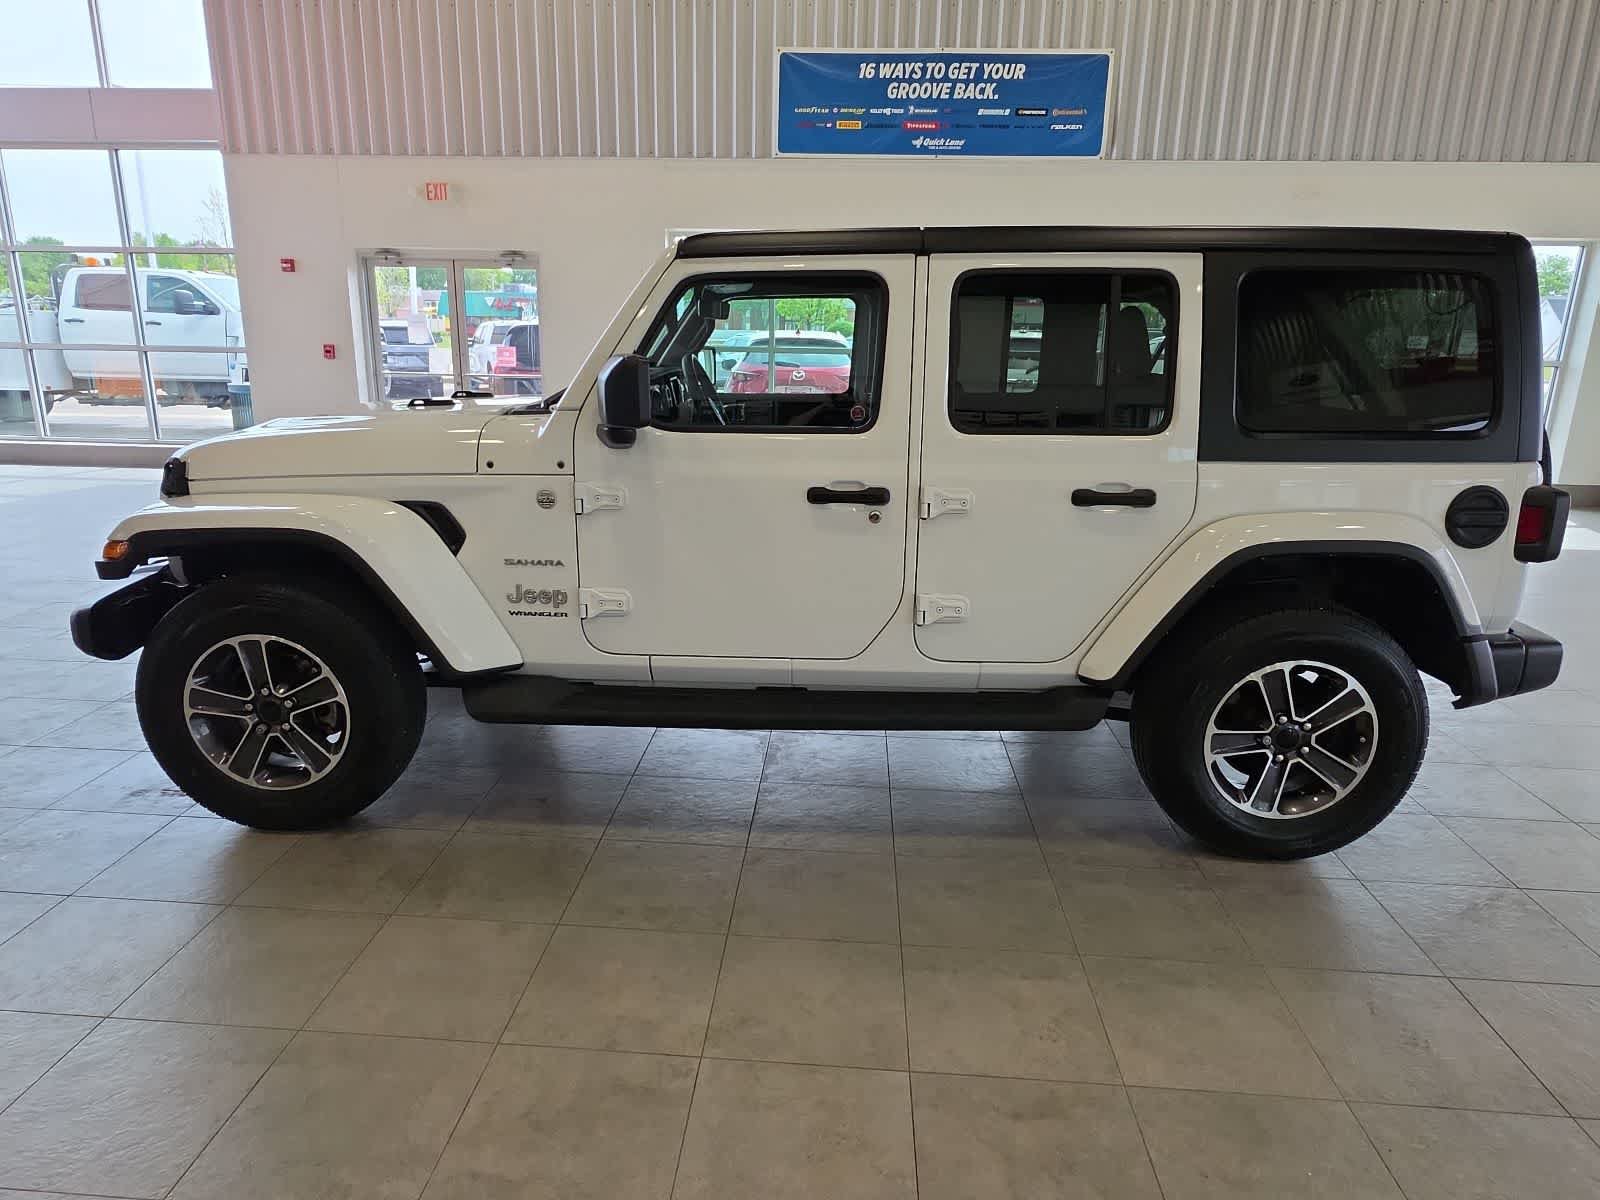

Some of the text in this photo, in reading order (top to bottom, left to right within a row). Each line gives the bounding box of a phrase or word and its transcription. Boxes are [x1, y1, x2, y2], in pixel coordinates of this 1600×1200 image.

[858, 62, 1026, 81] 16 WAYS TO GET YOUR
[887, 82, 999, 100] GROOVE BACK.
[922, 137, 966, 147] Quick Lane
[425, 183, 448, 201] EXIT
[503, 558, 565, 567] SAHARA
[506, 583, 568, 608] Jeep
[507, 609, 569, 618] WRANGLER
